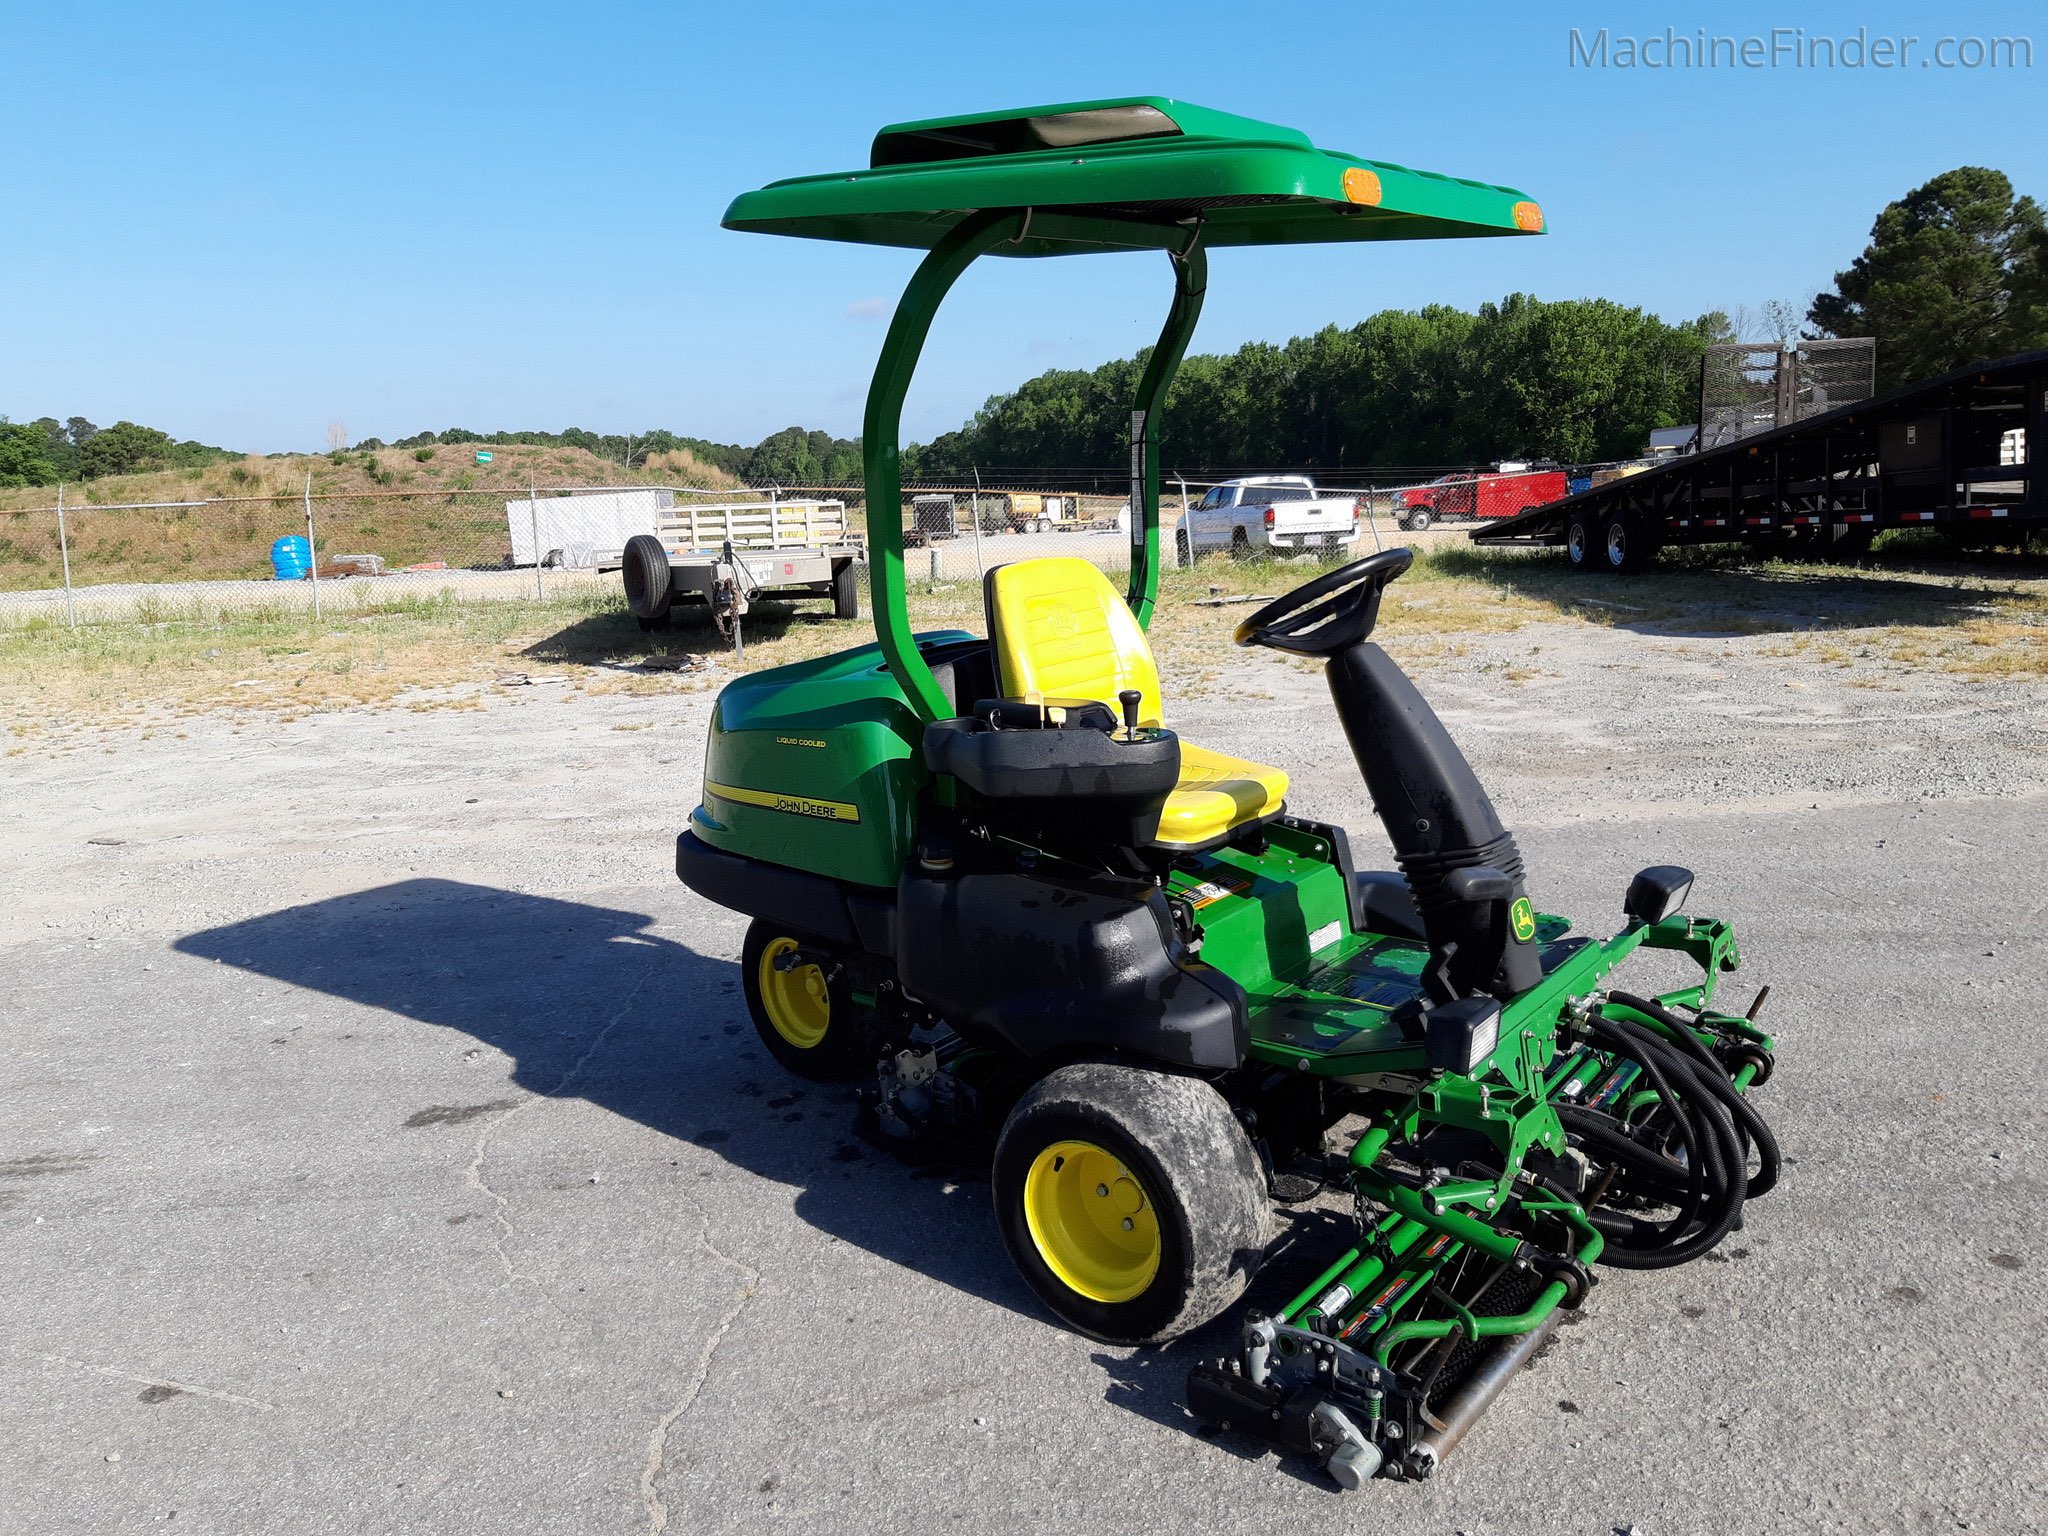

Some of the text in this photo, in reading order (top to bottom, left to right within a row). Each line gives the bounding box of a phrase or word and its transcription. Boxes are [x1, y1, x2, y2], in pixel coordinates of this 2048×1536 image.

[776, 736, 826, 748] LIQUID COOLED
[774, 797, 837, 818] JOHN DEERE
